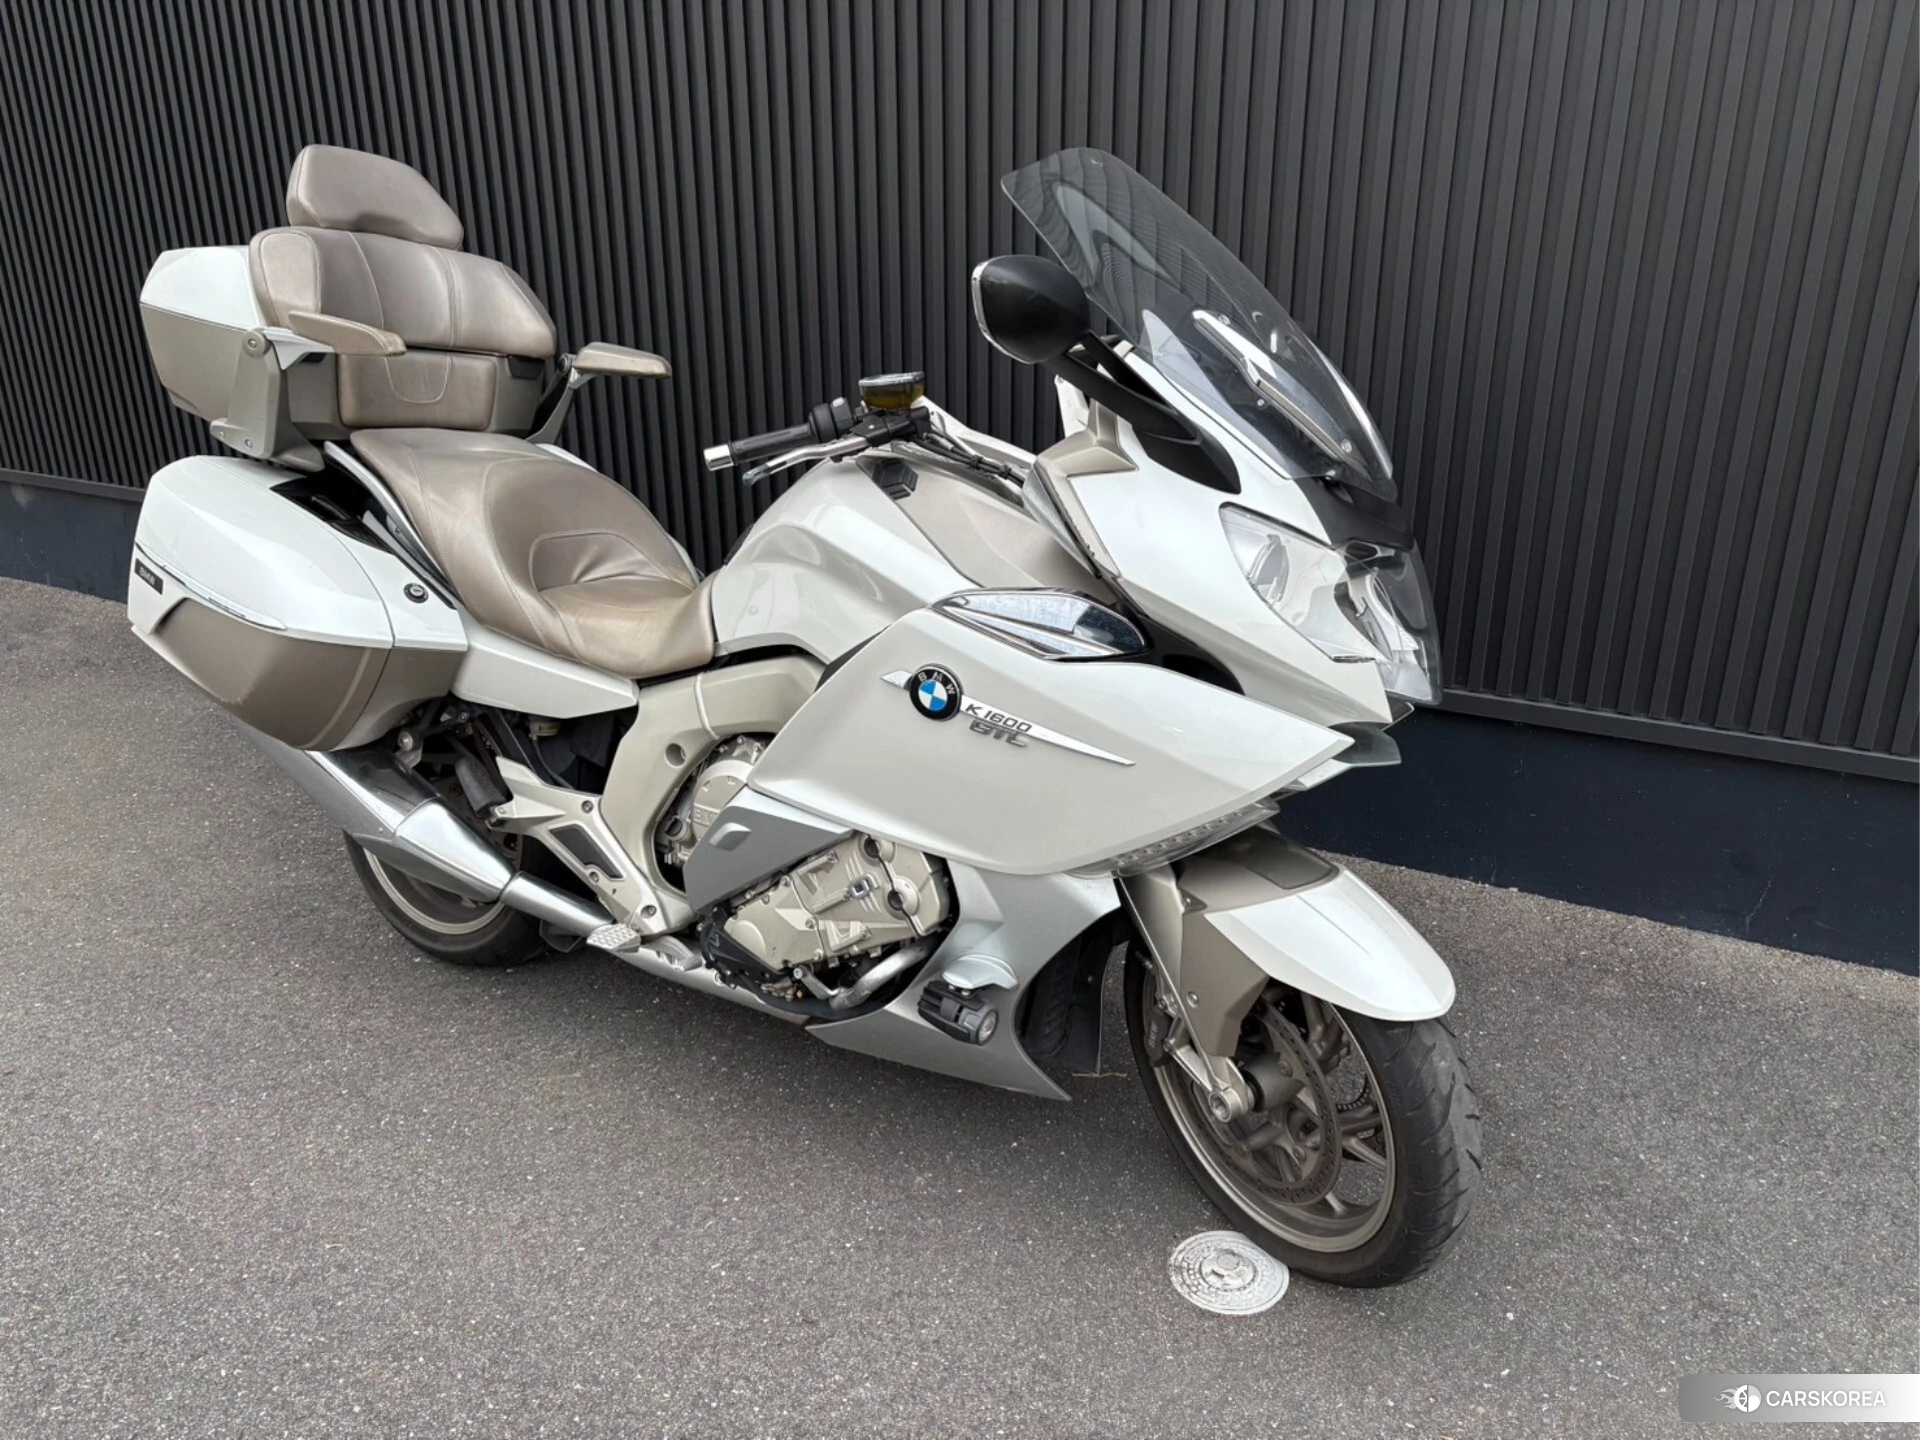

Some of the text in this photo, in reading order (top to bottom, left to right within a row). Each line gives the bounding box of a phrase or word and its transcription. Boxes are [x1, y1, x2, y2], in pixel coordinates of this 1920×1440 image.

[918, 671, 956, 695] BMW
[965, 703, 1032, 733] K 1600
